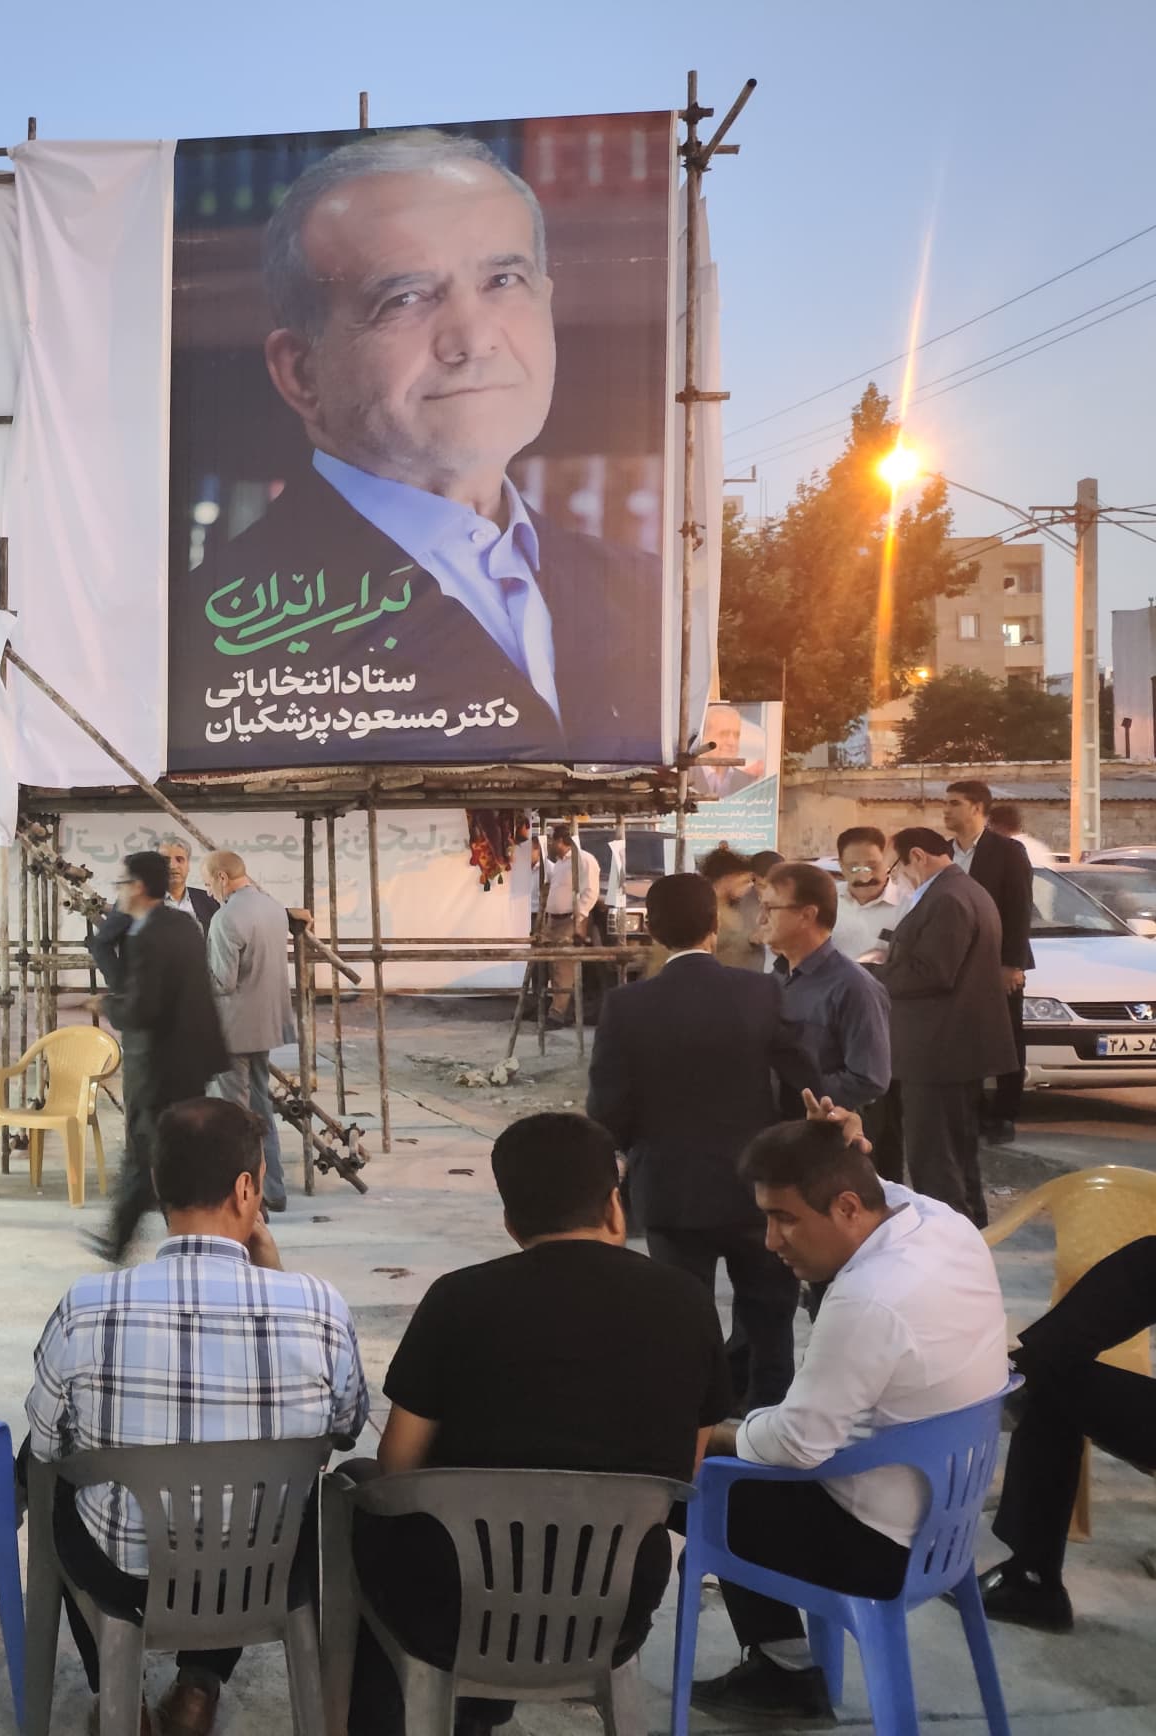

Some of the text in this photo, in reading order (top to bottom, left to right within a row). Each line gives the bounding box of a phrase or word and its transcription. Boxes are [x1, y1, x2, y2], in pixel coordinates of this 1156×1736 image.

[205, 664, 417, 708] ستاد انتخاباتی
[205, 697, 520, 745] دکتر مسعود پزشکیان
